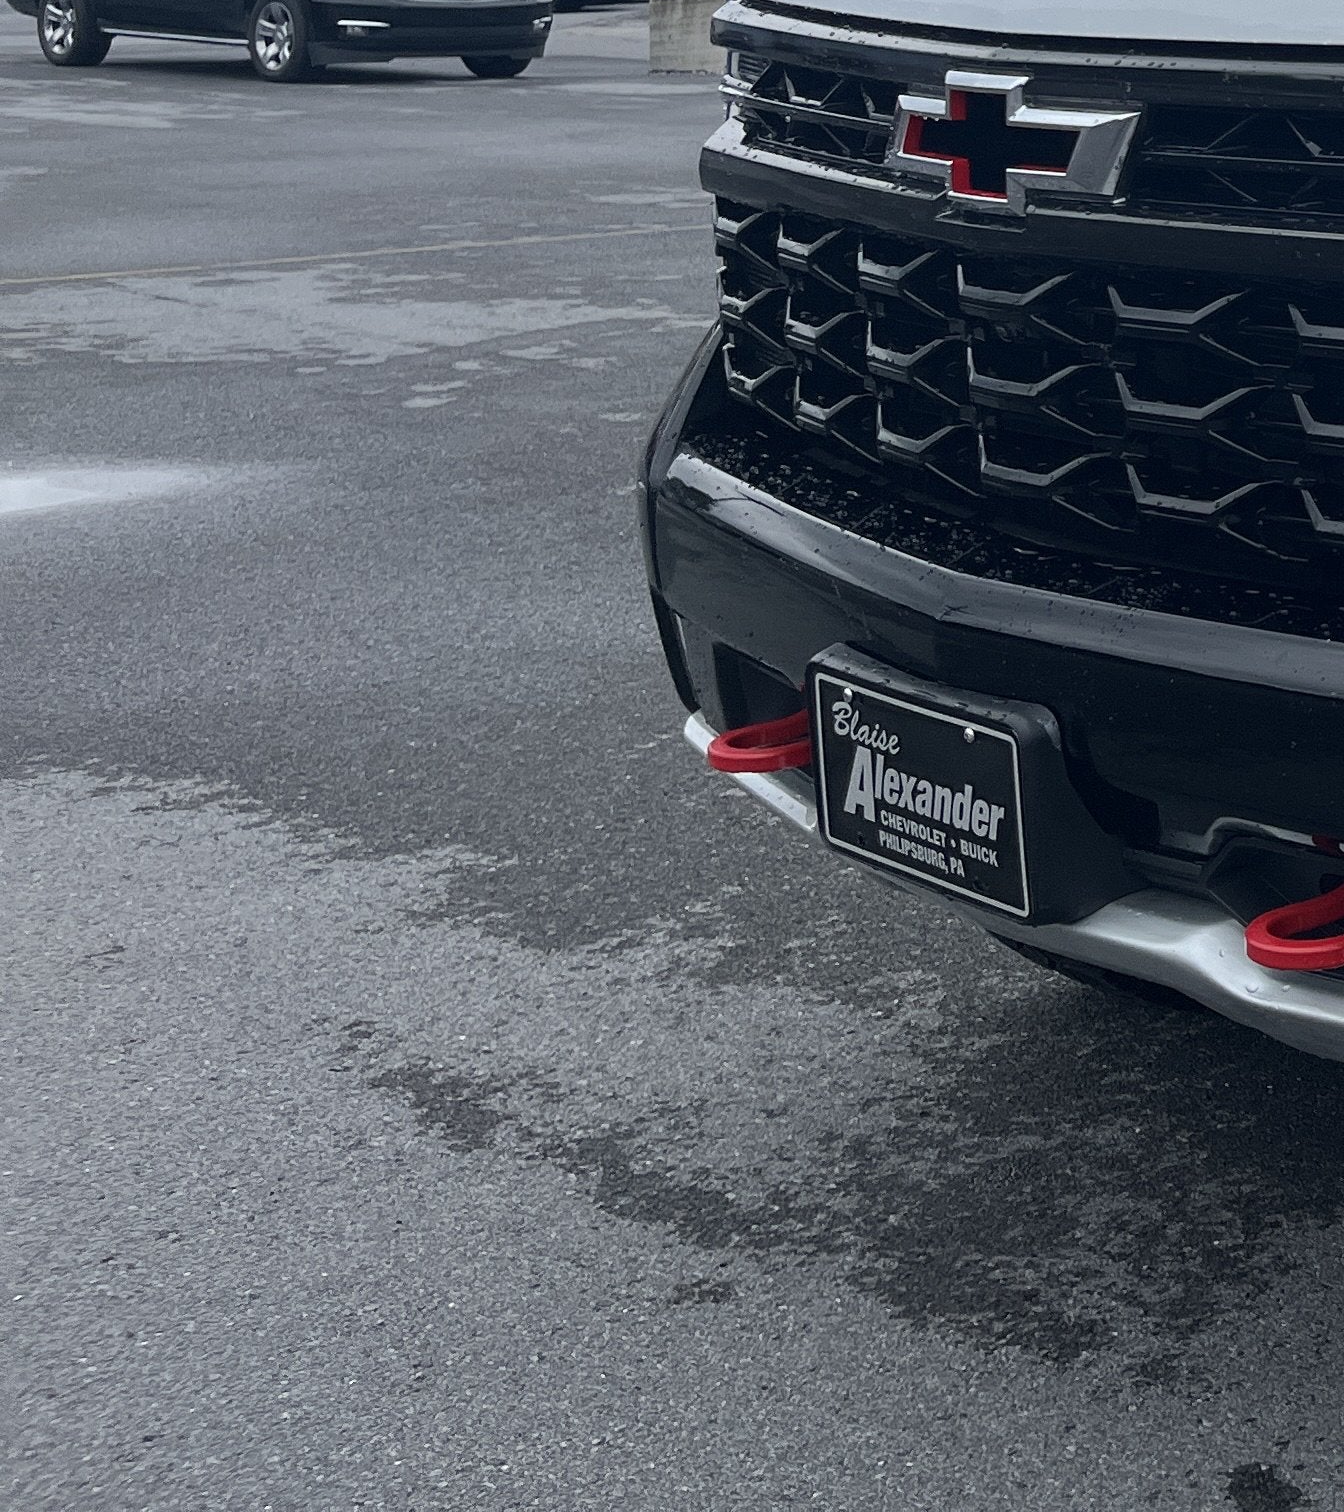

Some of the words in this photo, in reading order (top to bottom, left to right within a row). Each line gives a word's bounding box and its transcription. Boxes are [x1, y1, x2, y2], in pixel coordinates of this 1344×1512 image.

[832, 701, 900, 755] Blaise
[844, 745, 1005, 841] Alexander
[880, 809, 947, 849] CHEVROLET
[960, 838, 999, 867] BUICK
[950, 856, 965, 878] PA
